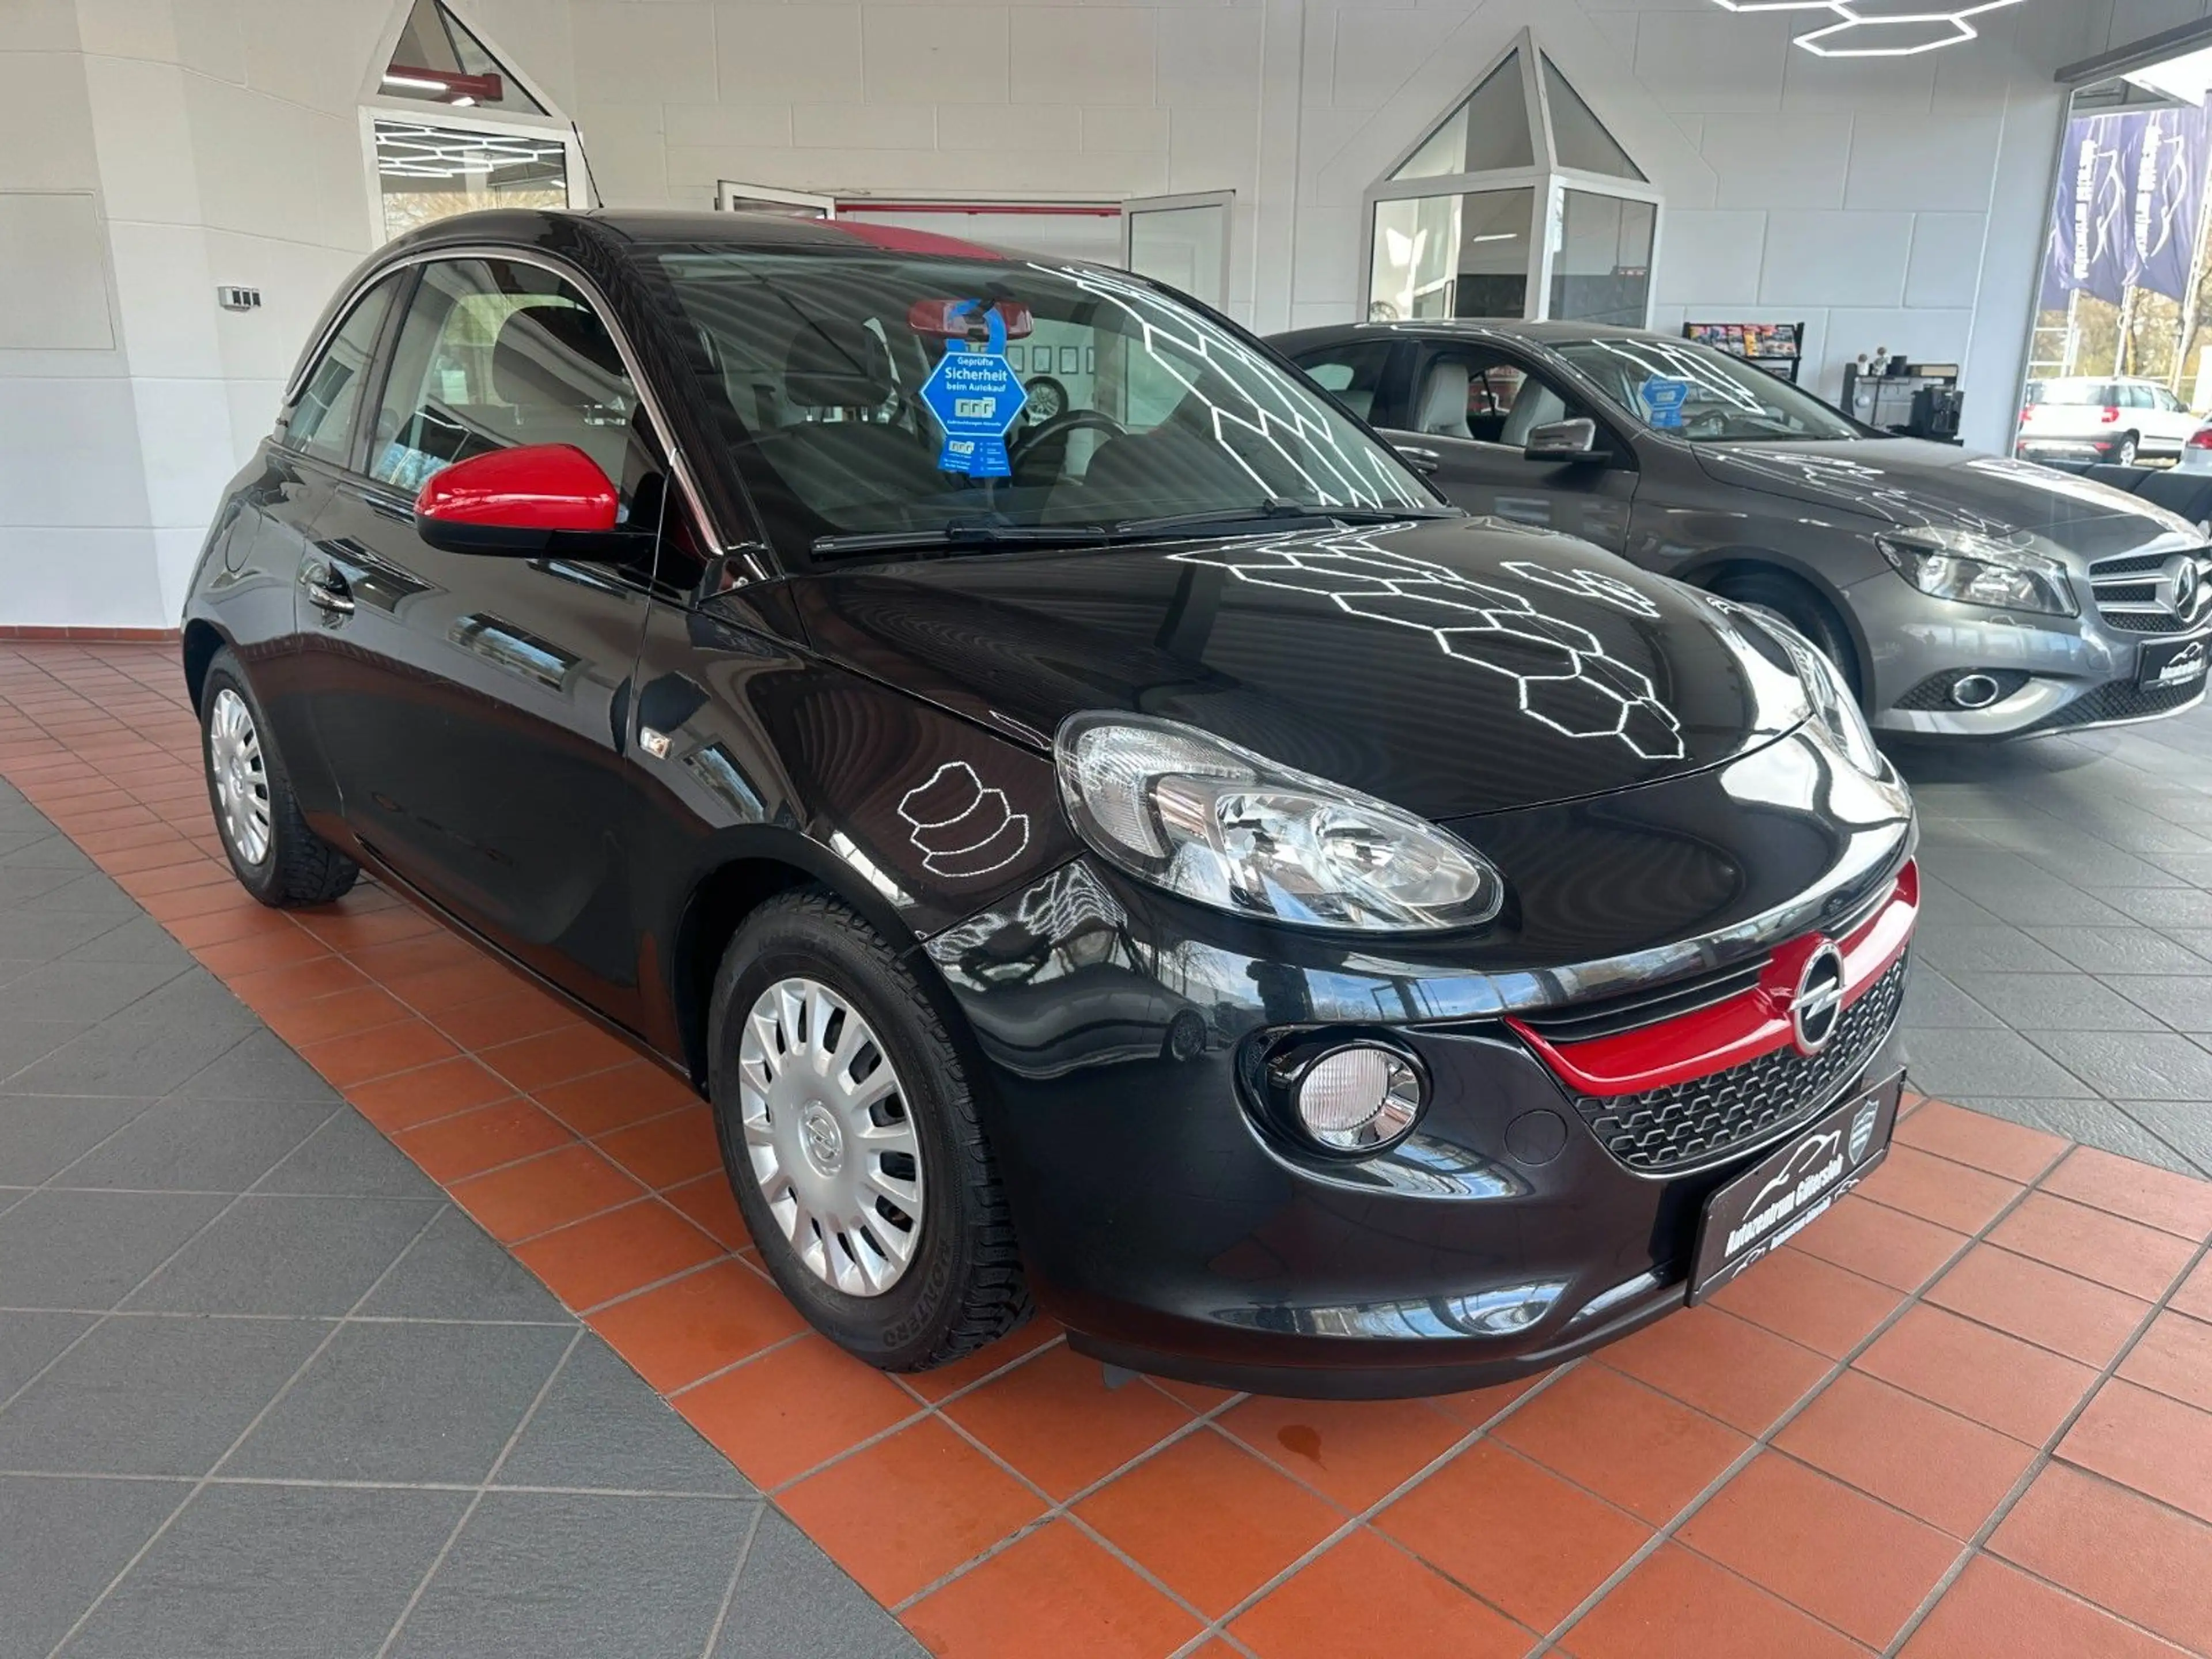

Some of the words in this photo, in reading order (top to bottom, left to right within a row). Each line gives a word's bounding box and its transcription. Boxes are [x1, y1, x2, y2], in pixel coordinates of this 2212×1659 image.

[957, 357, 994, 367] Geprüfte
[945, 367, 1007, 381] Sicherheit
[946, 381, 967, 391] beim
[969, 383, 1006, 392] Autokauf
